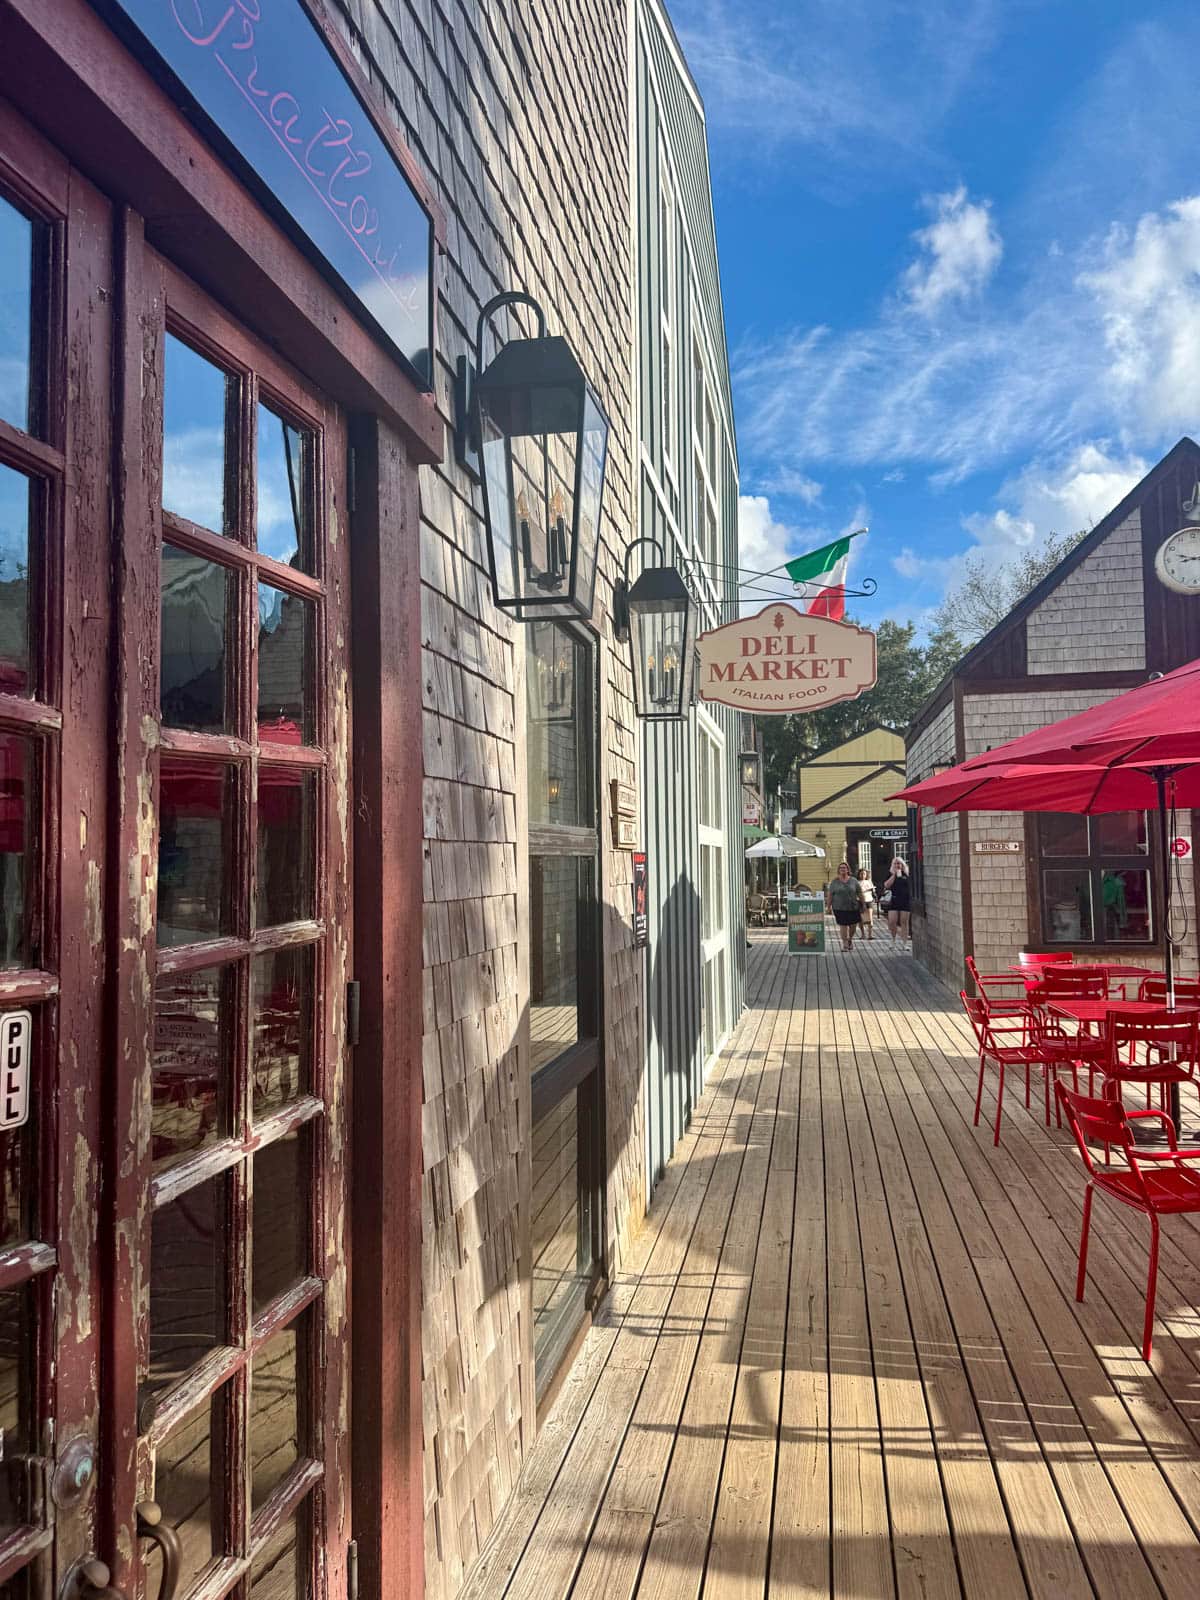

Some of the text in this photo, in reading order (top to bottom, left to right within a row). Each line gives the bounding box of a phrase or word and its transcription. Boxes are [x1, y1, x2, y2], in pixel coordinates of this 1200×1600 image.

[740, 634, 817, 657] DELI
[708, 657, 853, 683] MARKET
[732, 684, 828, 702] ITALIAN FOOD
[980, 843, 1010, 851] BURGERS
[5, 1021, 22, 1120] PULL
